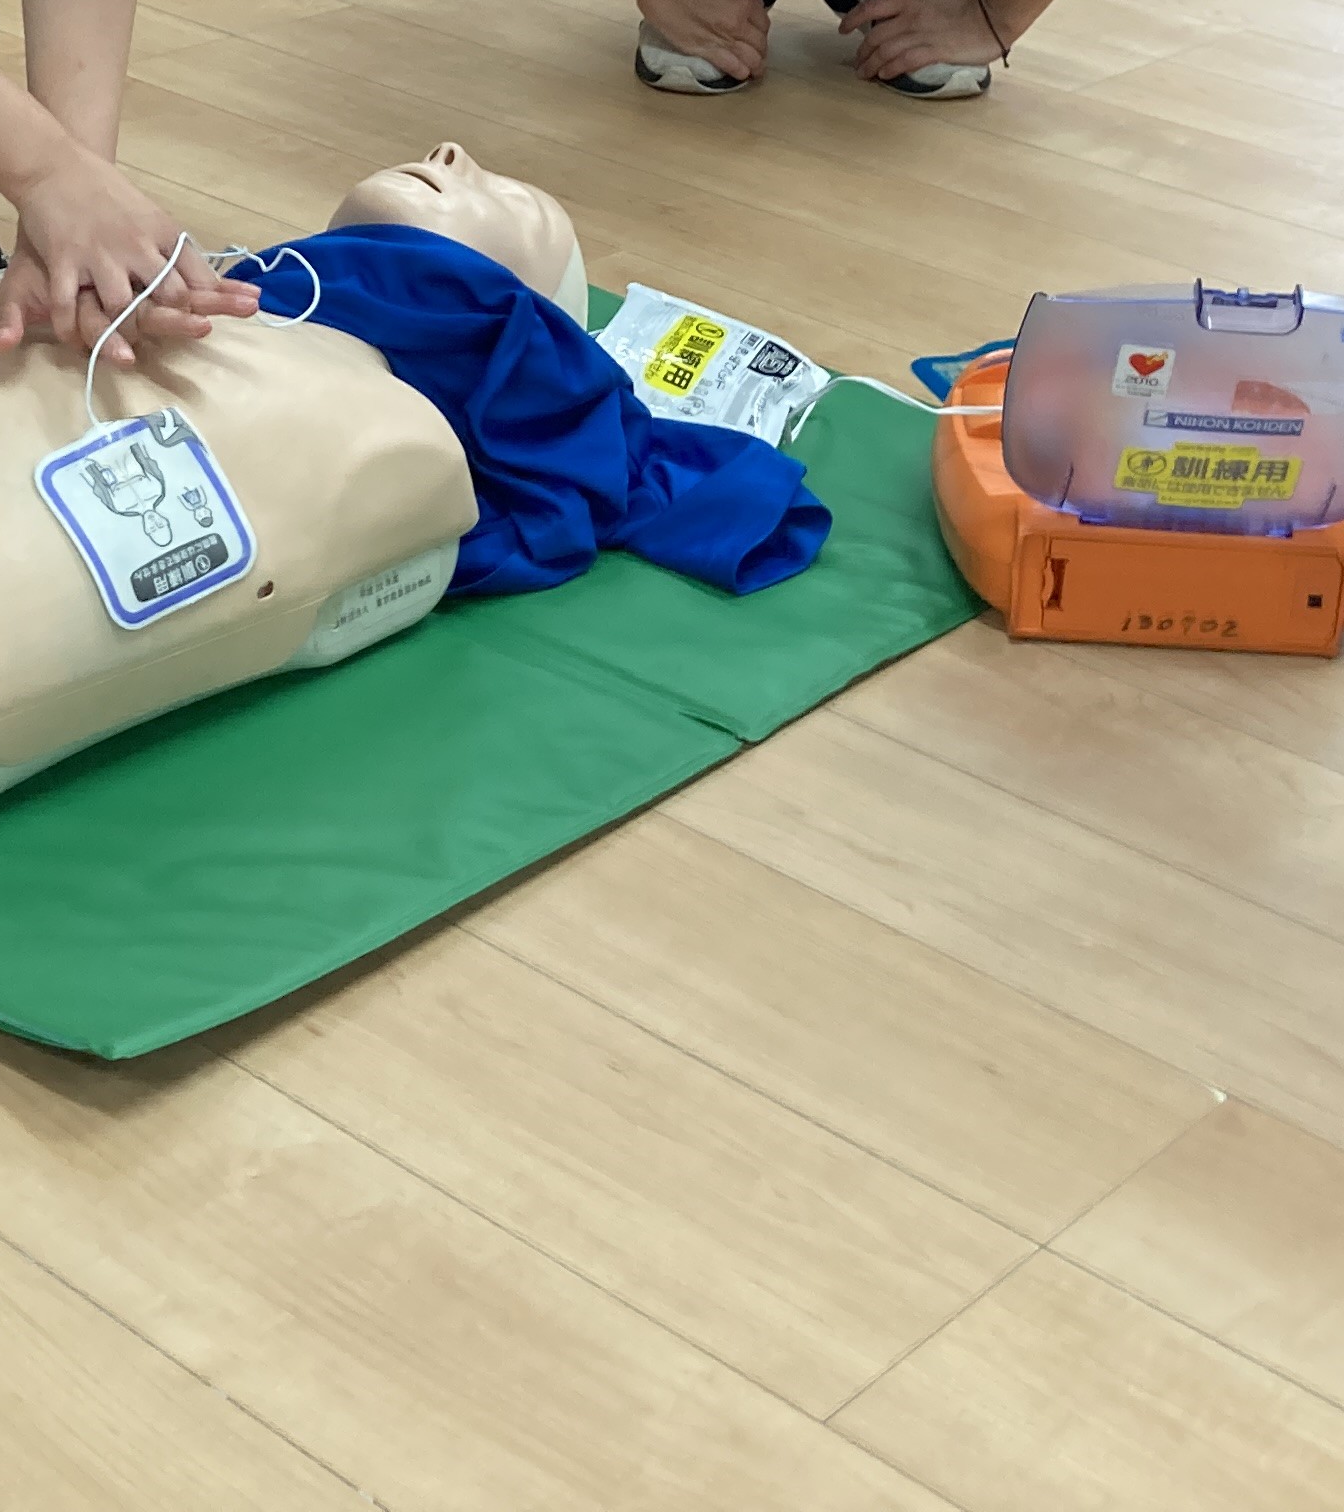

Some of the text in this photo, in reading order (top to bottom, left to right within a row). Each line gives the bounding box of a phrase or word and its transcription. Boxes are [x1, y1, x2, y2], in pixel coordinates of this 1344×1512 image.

[1174, 415, 1303, 433] NIHON KOHDEN
[1171, 456, 1290, 483] 訓練用
